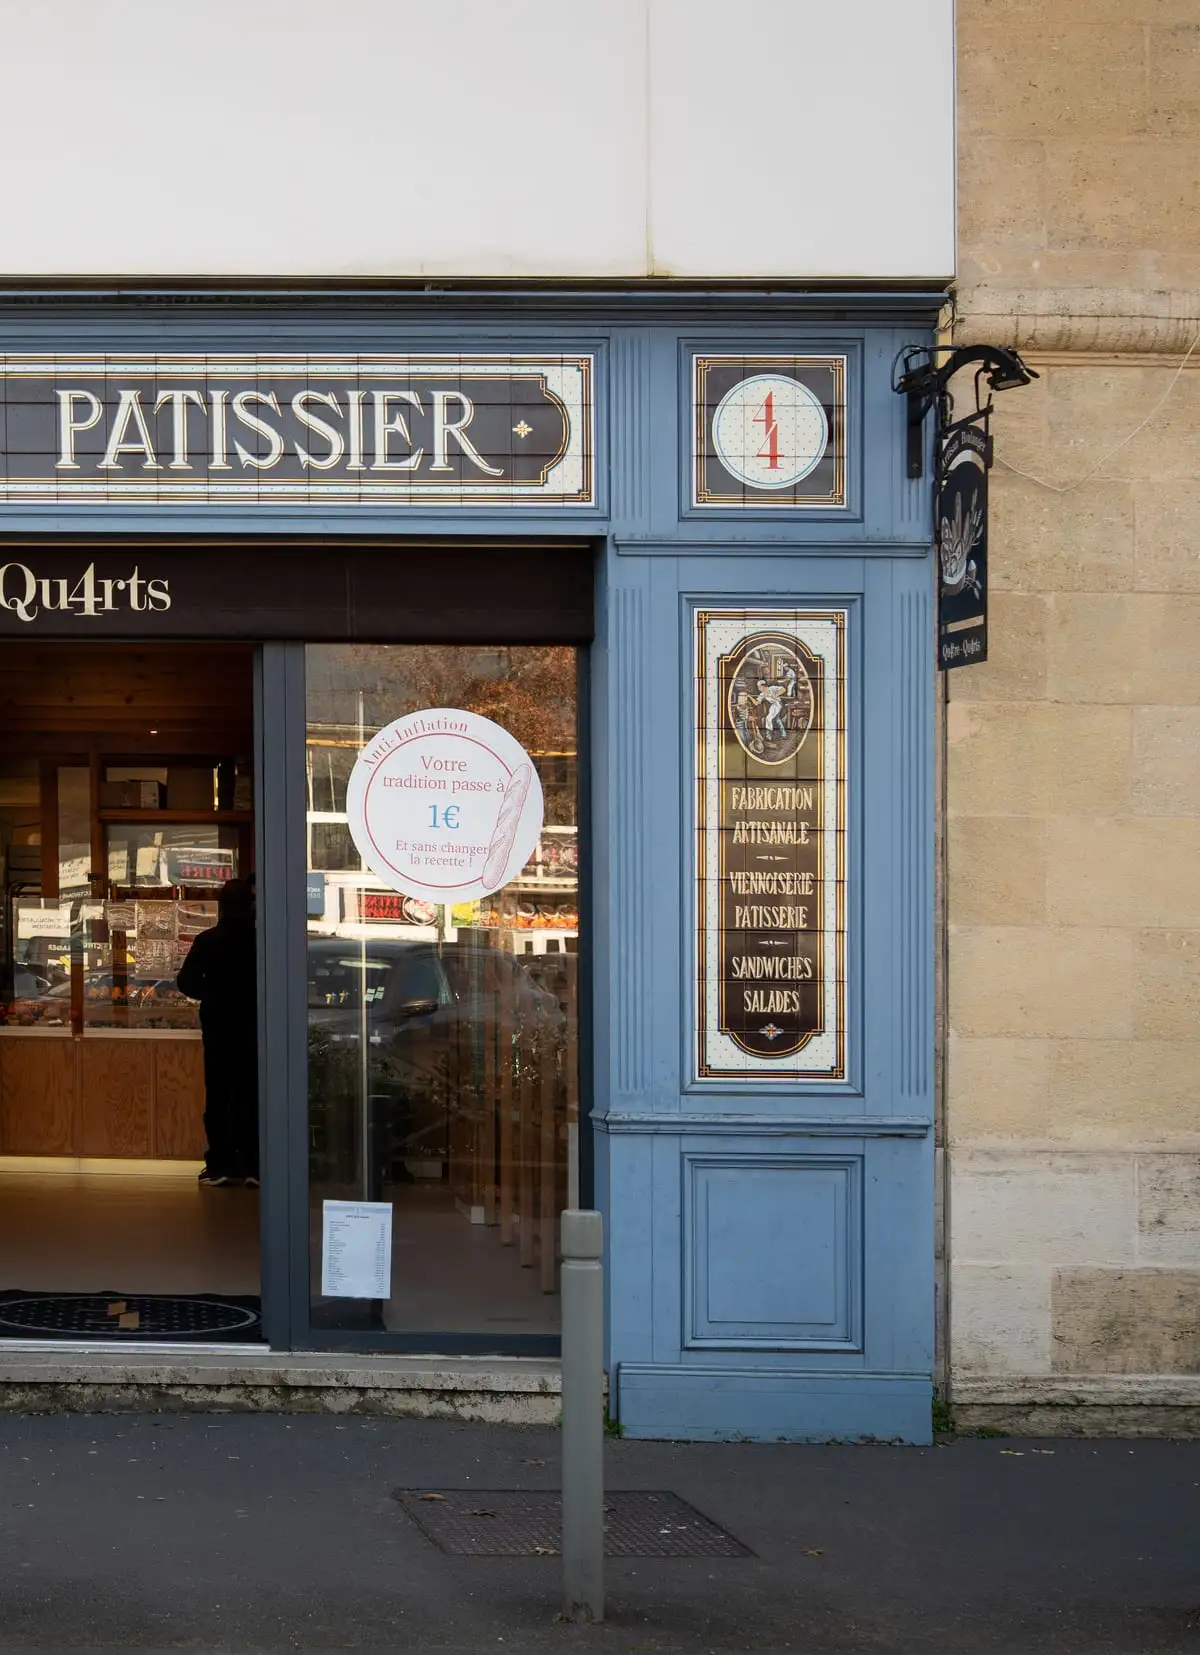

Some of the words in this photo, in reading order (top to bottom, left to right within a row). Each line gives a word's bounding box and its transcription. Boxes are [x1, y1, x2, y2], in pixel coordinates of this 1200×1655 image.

[54, 389, 504, 476] PATISSIER
[420, 755, 468, 772] Votre
[383, 775, 447, 791] tradition
[452, 779, 492, 794] passe
[496, 778, 505, 793] à
[731, 787, 813, 810] FABRICATION
[428, 804, 461, 830] 1€
[732, 821, 810, 845] ARTISANALE
[395, 839, 409, 851] Et
[412, 842, 437, 853] sans
[441, 841, 489, 857] changer
[410, 854, 421, 866] la
[424, 856, 465, 867] recette
[729, 871, 815, 895] VIENNOISERIE
[735, 905, 808, 929] PATISSERIE
[731, 956, 812, 979] SANDWICHES
[743, 990, 800, 1013] SALADES
